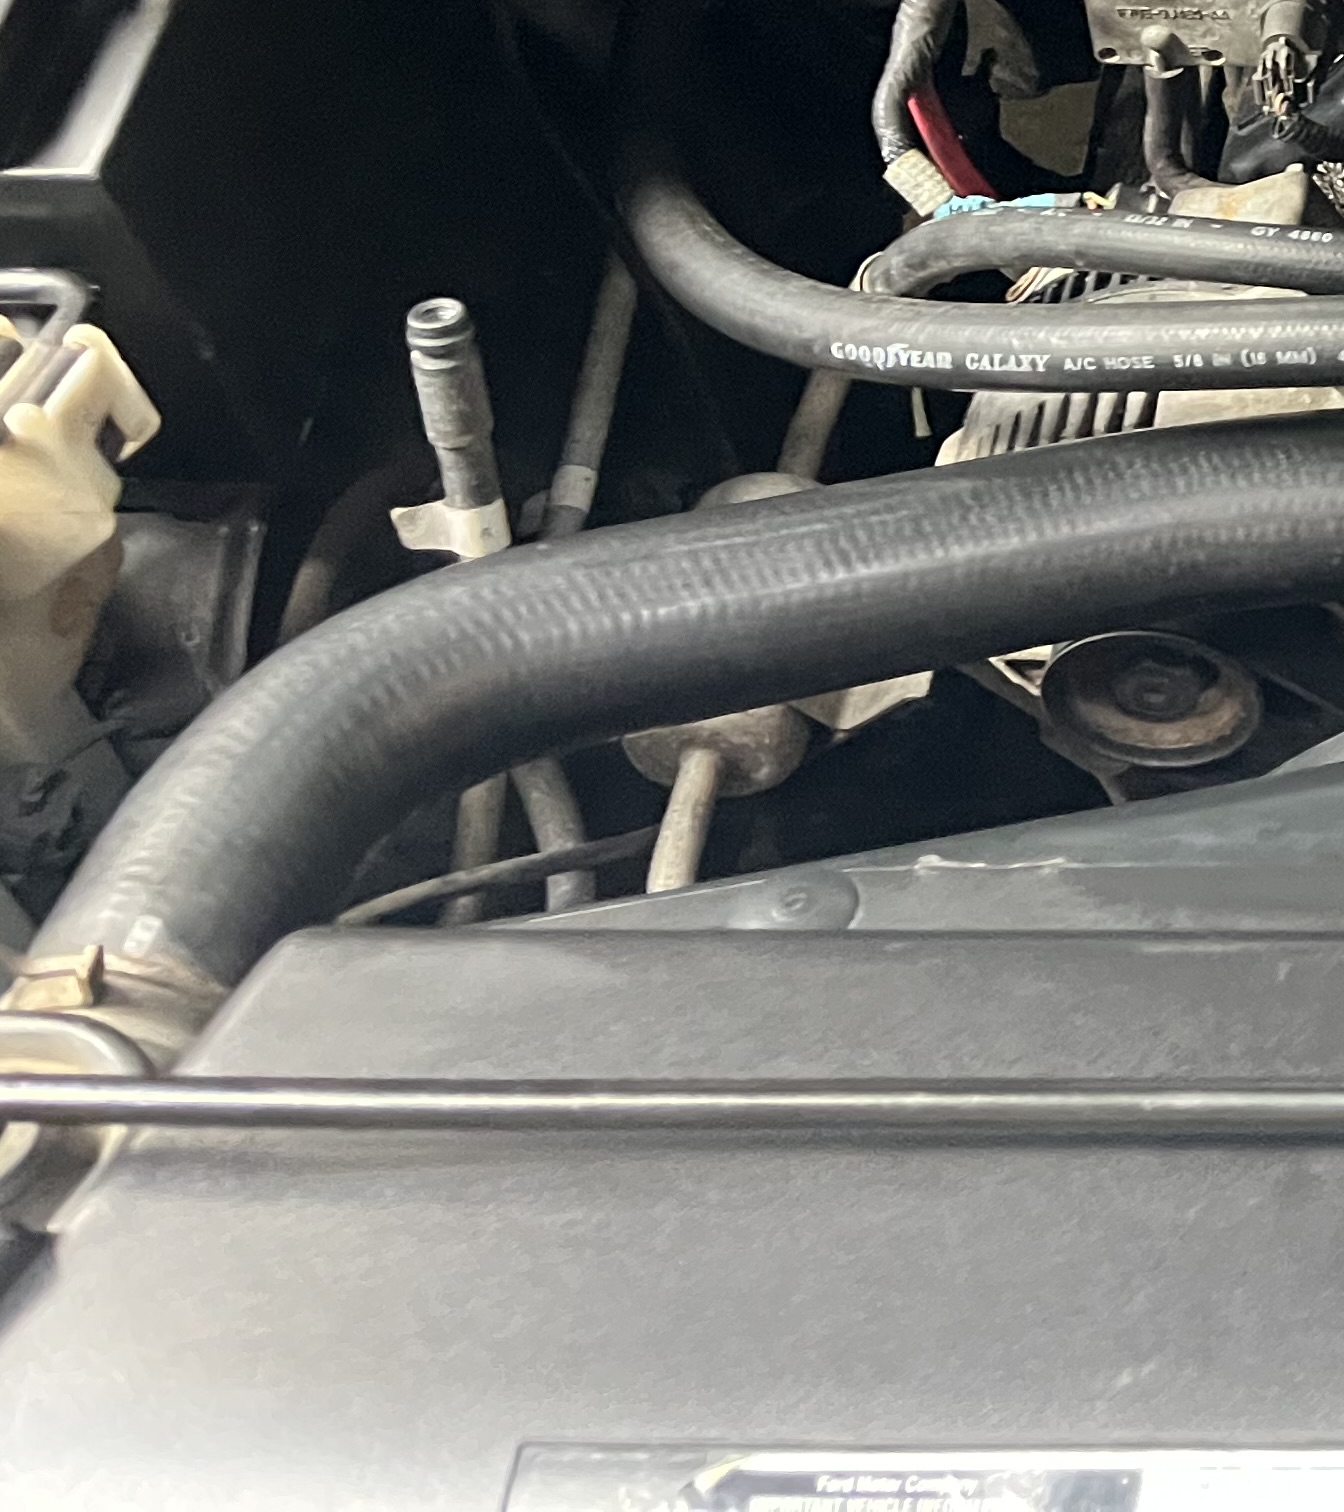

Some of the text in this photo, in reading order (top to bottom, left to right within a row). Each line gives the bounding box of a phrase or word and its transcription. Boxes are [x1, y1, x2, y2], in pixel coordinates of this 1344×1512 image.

[1250, 226, 1280, 237] GY
[830, 342, 953, 370] GOODYEAR
[965, 352, 1050, 372] GALAXY
[1063, 357, 1097, 371] A/C
[1103, 356, 1155, 370] HOSE
[1172, 353, 1203, 368] 5/8
[816, 1474, 855, 1493] Ford
